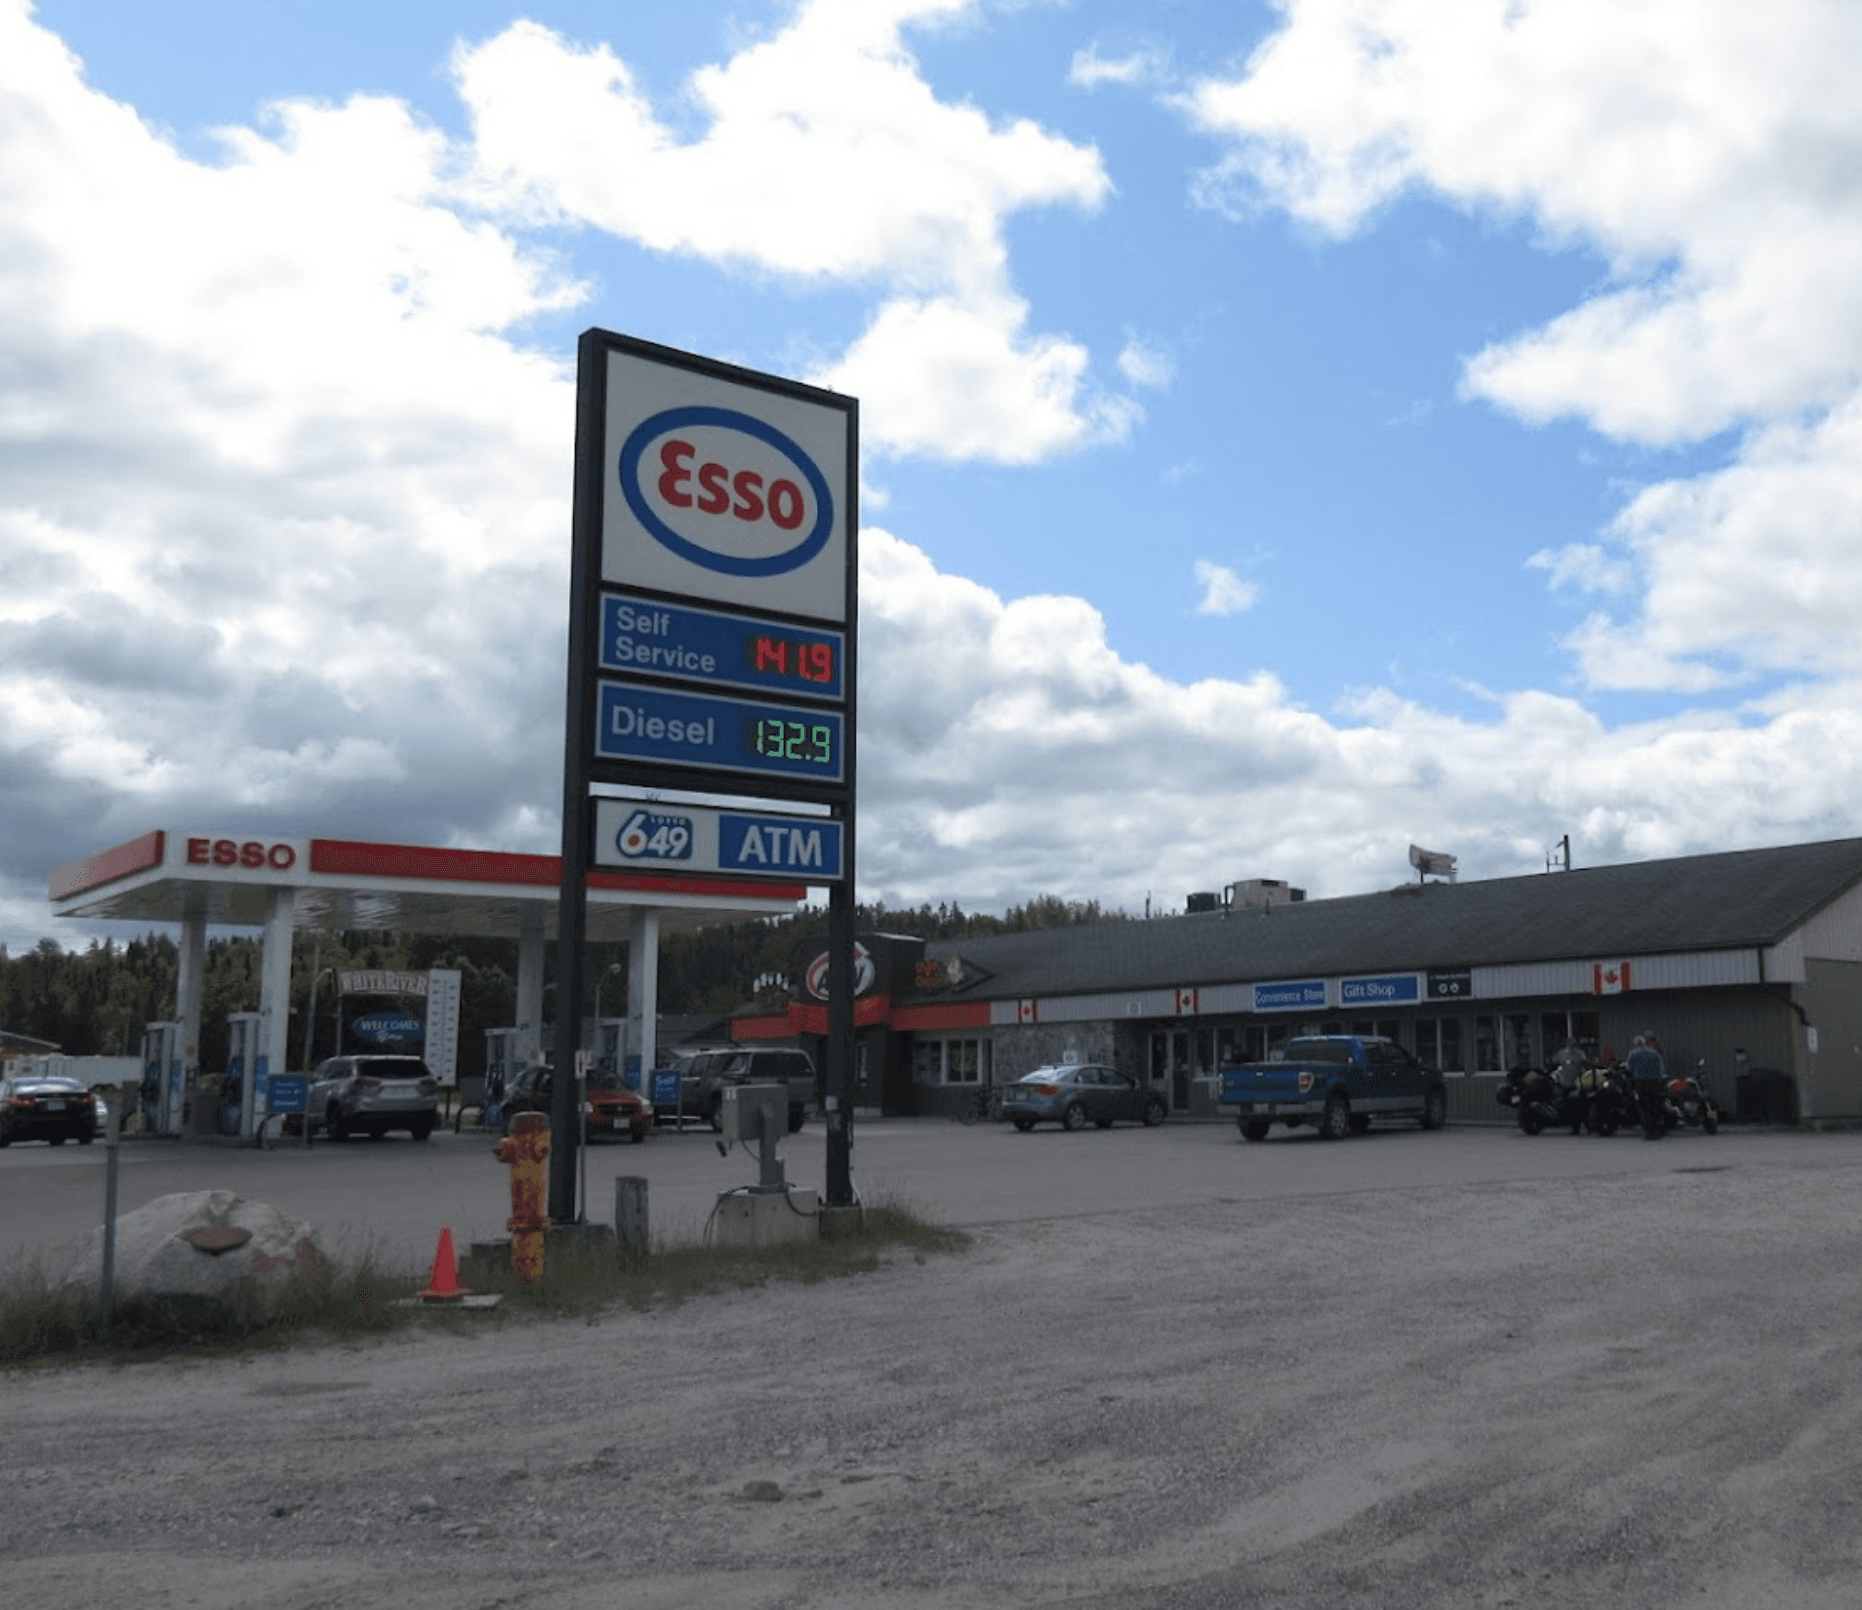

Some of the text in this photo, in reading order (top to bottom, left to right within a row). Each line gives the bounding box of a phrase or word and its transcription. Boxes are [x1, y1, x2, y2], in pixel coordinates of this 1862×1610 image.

[616, 605, 671, 637] Self
[615, 636, 716, 673] Service
[612, 705, 714, 746] Diesel
[757, 720, 831, 763] 132.9
[187, 838, 296, 870] ESSO
[738, 825, 823, 867] ATM
[1344, 982, 1395, 998] Gift Shop
[361, 1019, 420, 1031] WELCOMES
